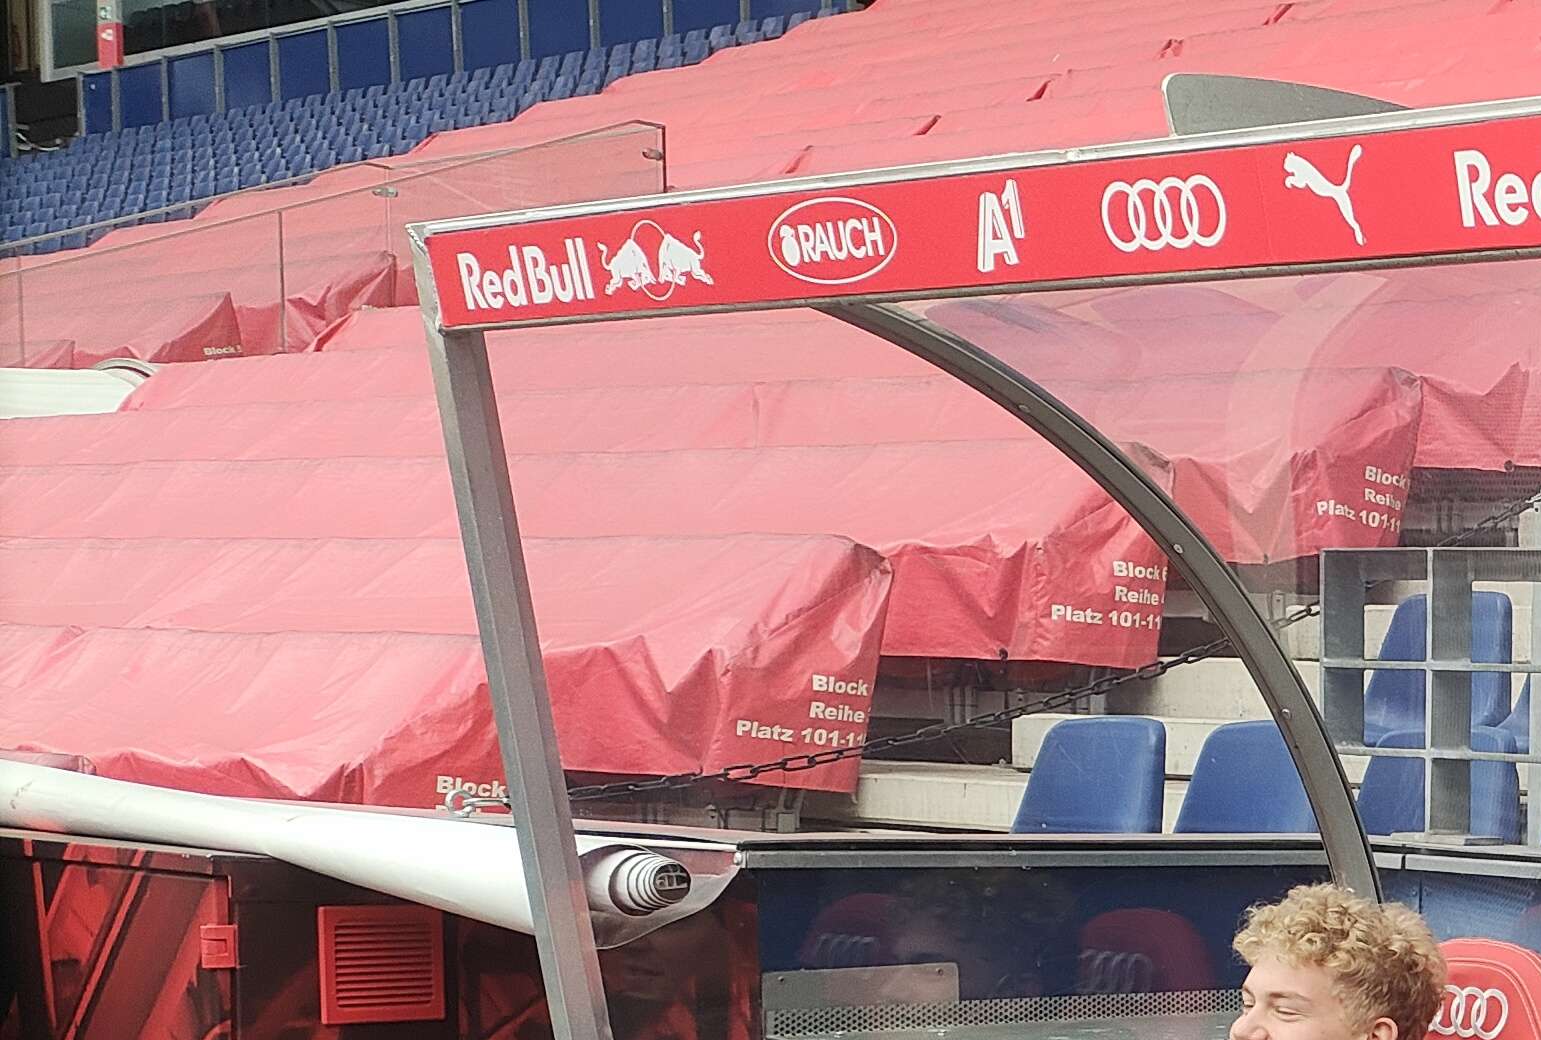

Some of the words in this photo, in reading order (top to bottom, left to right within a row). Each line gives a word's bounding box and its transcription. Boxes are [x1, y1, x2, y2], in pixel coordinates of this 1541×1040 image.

[977, 179, 1025, 273] A1
[797, 216, 885, 263] RAUCH
[204, 345, 236, 356] Block
[1364, 465, 1406, 489] Block
[1316, 499, 1356, 521] Platz
[1364, 487, 1401, 511] Reihe
[1112, 560, 1160, 581] Block
[1114, 585, 1159, 606] Reihe
[1050, 604, 1103, 625] Platz
[812, 674, 868, 696] Block
[809, 701, 865, 723] Reihe
[736, 719, 793, 742] Platz
[436, 775, 507, 798] Block
